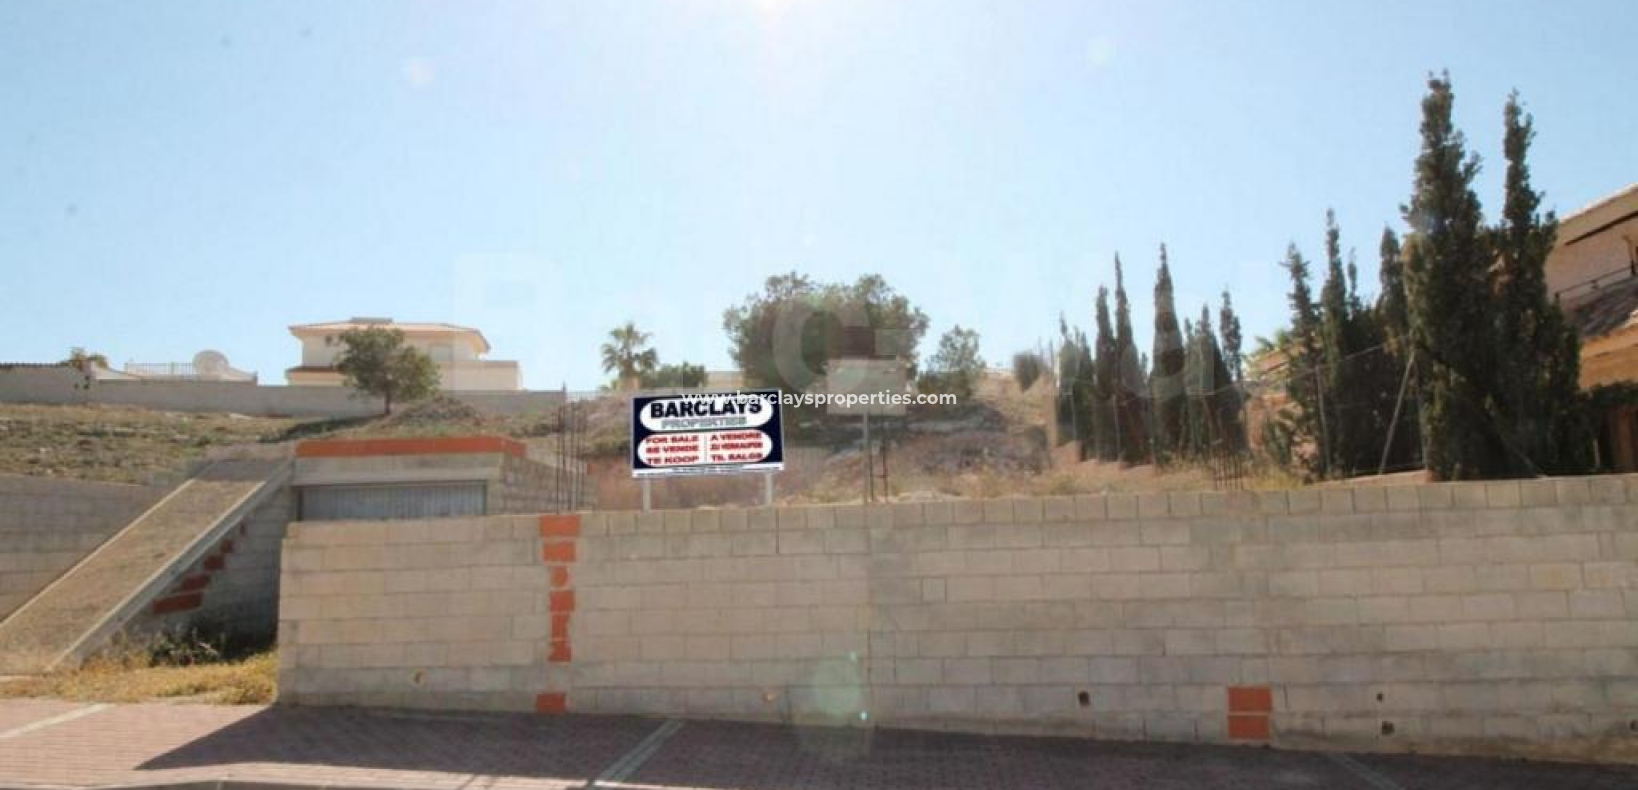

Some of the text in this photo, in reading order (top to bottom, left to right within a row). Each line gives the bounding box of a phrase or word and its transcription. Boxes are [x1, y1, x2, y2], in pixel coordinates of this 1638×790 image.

[651, 397, 762, 419] BARCLAYS
[645, 434, 700, 444] FOR SALE
[664, 455, 700, 464] KOOP
